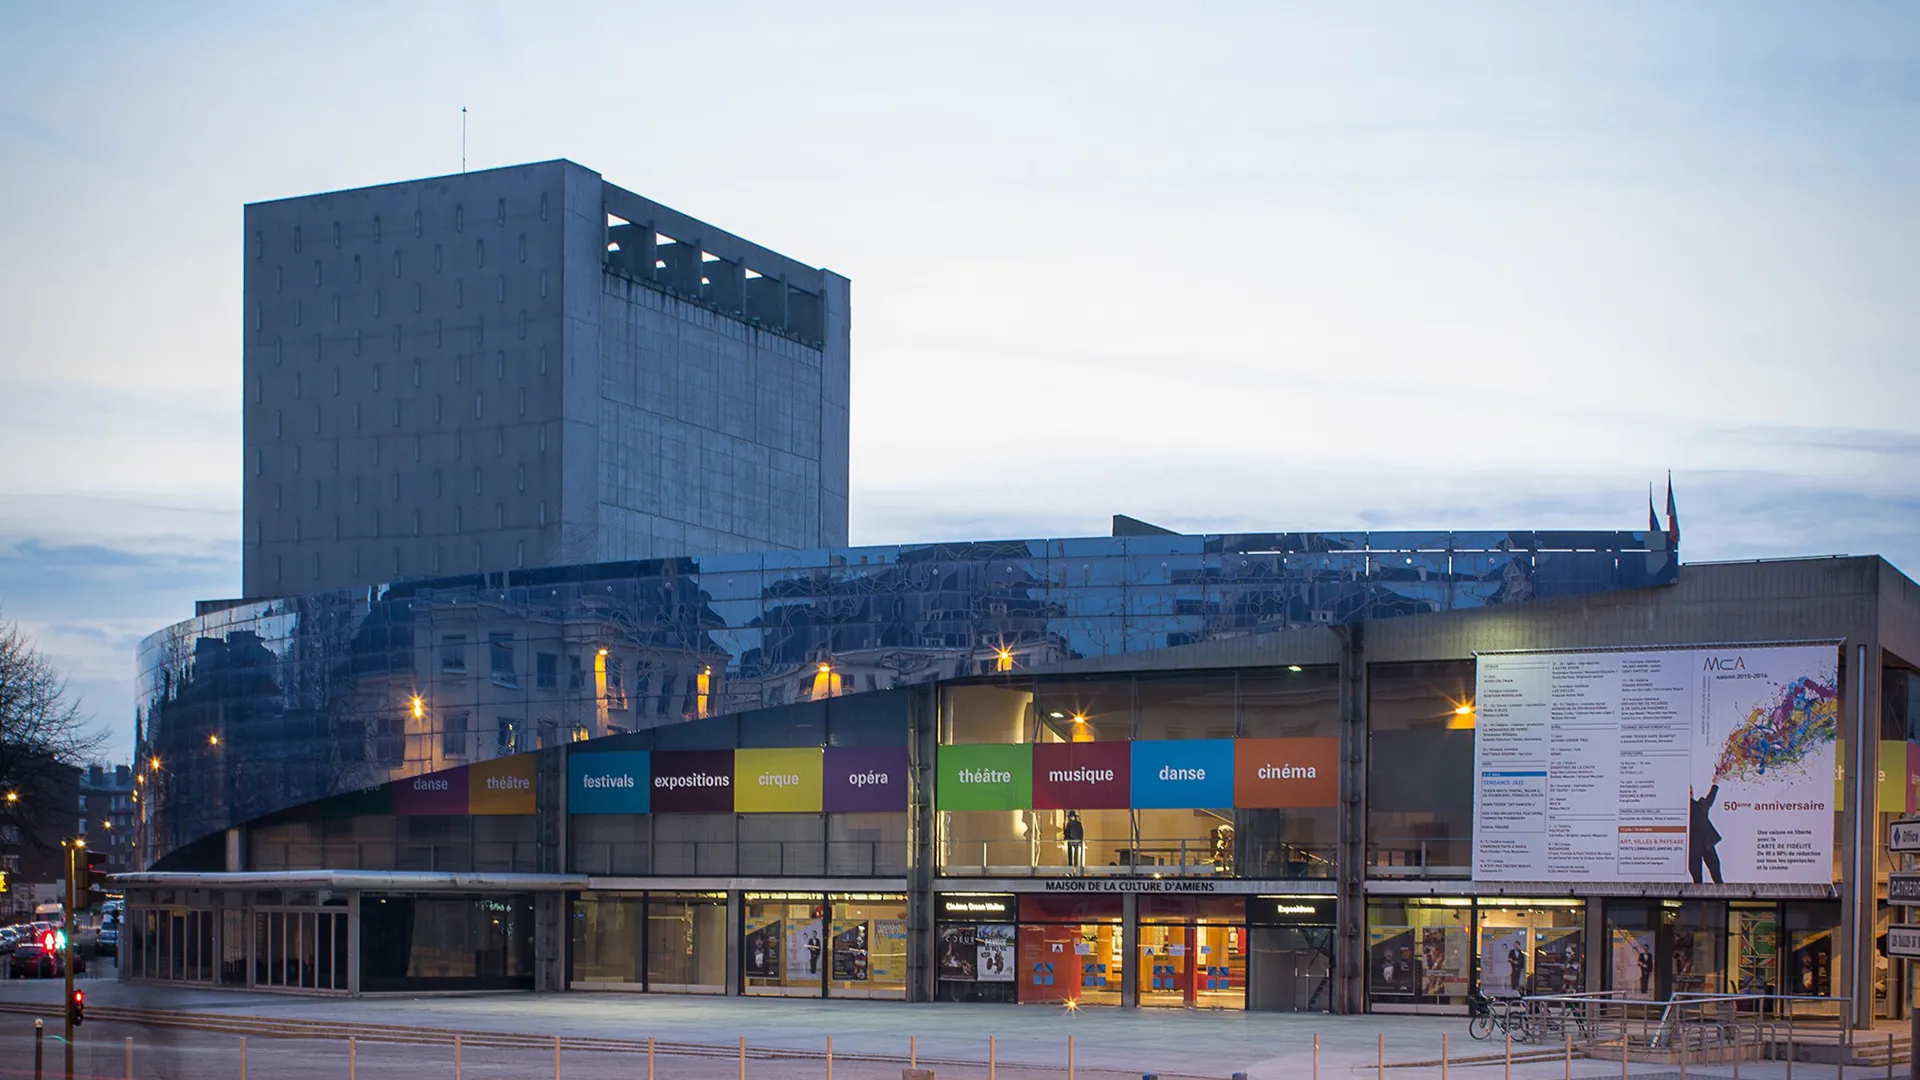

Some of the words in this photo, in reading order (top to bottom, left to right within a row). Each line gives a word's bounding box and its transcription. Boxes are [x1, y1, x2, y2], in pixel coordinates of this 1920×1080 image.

[849, 770, 888, 787] opéra
[958, 768, 1012, 783] théâtre
[1049, 767, 1114, 786] musique
[1159, 765, 1206, 781] danse
[1257, 763, 1317, 780] cinéma
[413, 778, 449, 790] danse
[487, 776, 530, 789] théâtre
[583, 773, 634, 788] festivals
[654, 772, 730, 790] expositions
[758, 772, 799, 788] cirque
[1754, 801, 1825, 811] anniversaire
[1903, 830, 1919, 843] Office
[1045, 881, 1085, 891] MAISON
[1088, 882, 1100, 891] DE
[1103, 882, 1116, 891] LA
[1119, 882, 1161, 891] CULTURE
[1165, 882, 1214, 891] D'AMIENS
